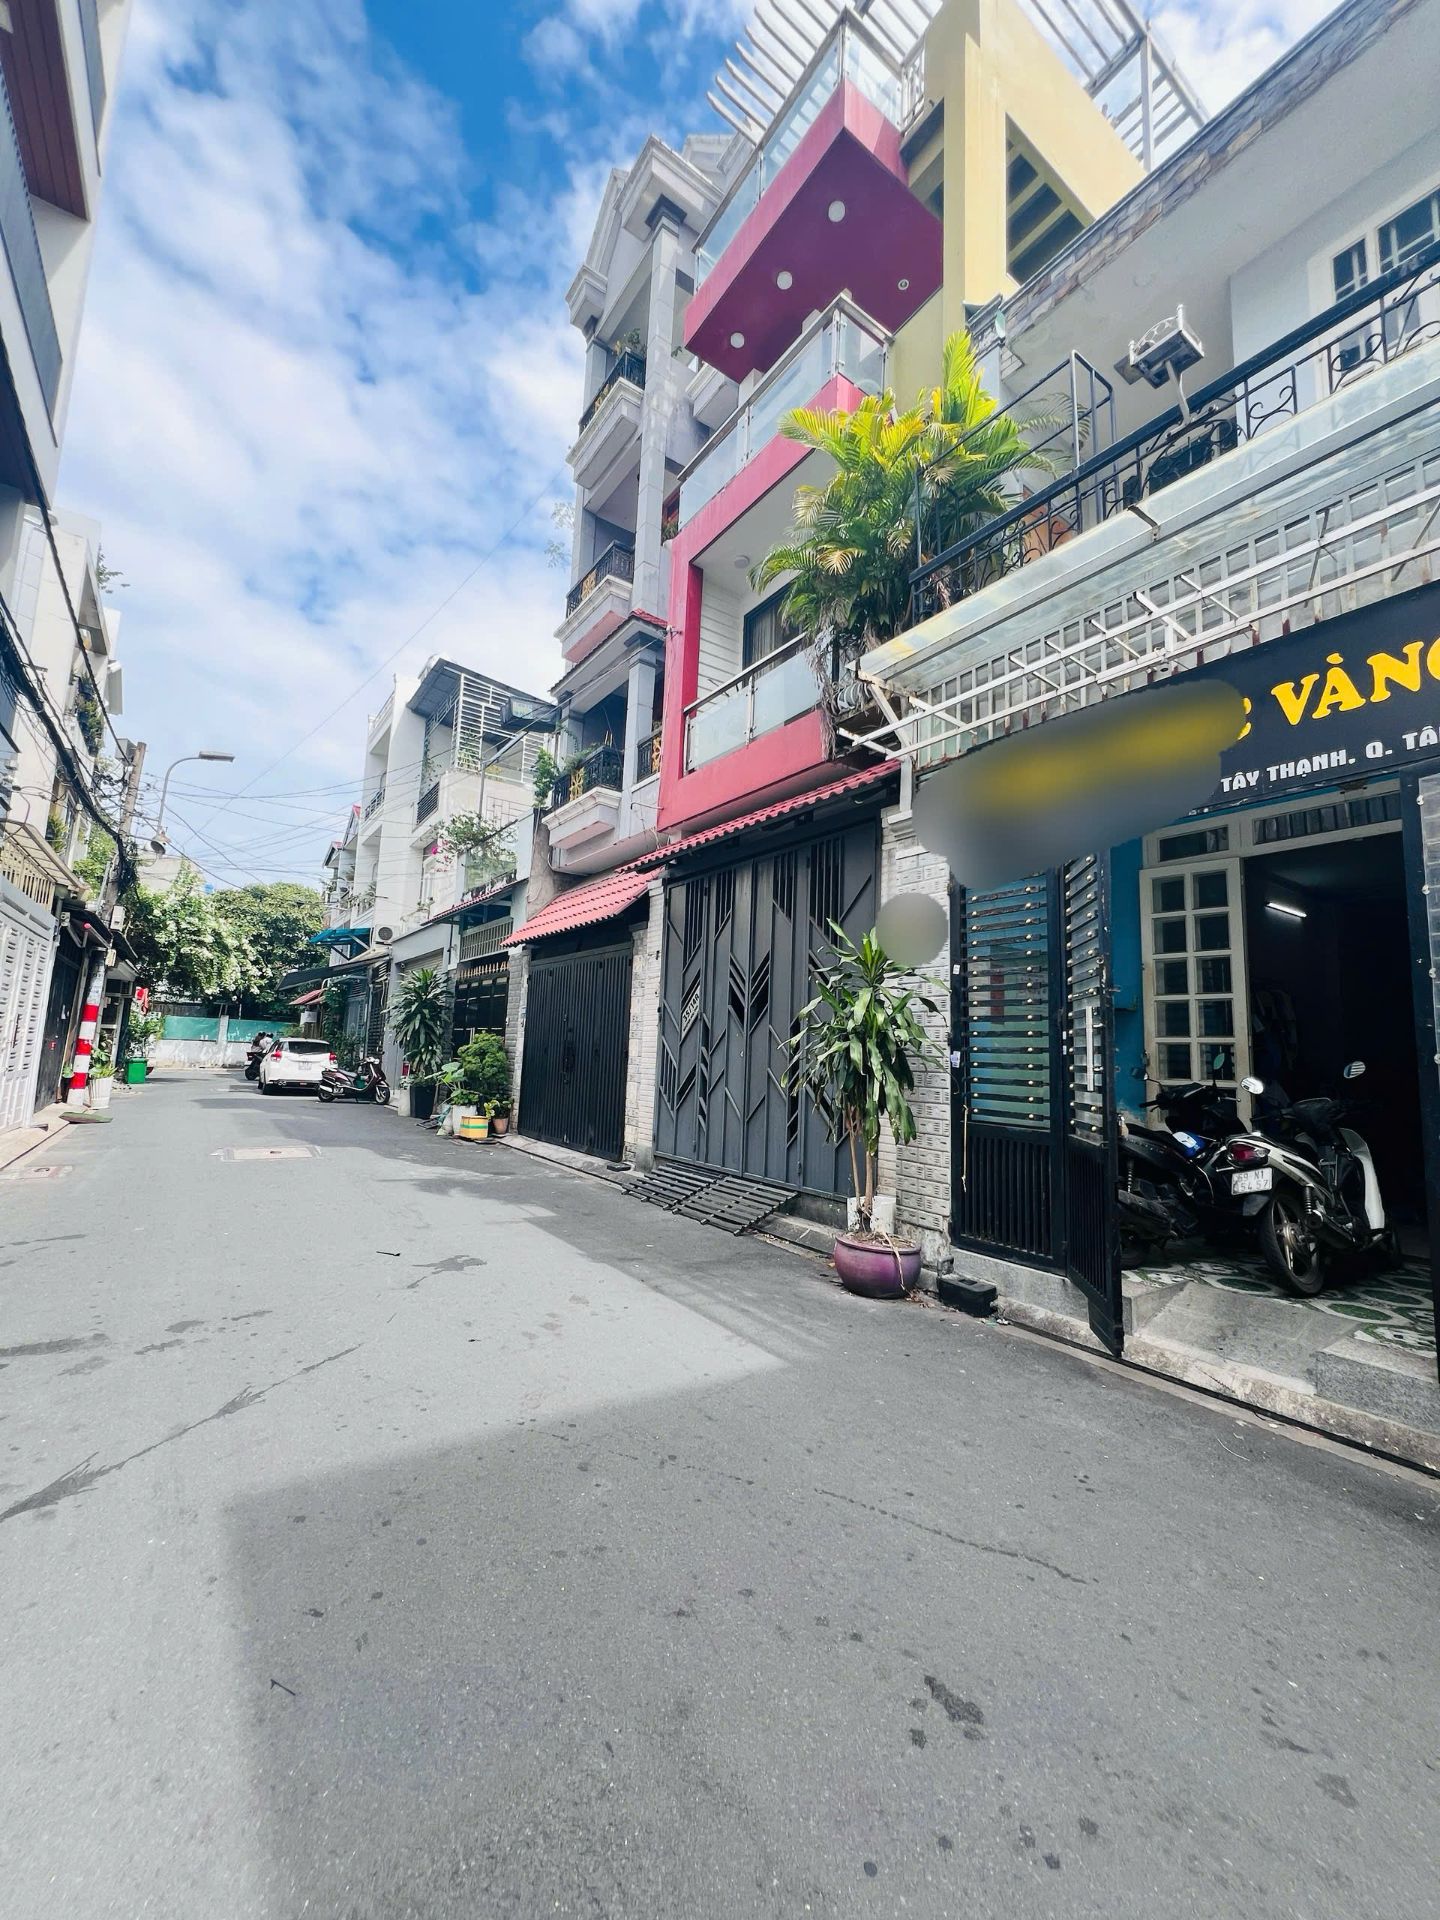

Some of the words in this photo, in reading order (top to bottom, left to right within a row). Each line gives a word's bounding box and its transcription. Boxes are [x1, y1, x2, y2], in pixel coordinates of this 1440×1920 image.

[1270, 635, 1440, 726] VÀN
[1220, 770, 1260, 793] TÂY
[1365, 741, 1393, 760] Q.
[1402, 724, 1440, 751] TÂ
